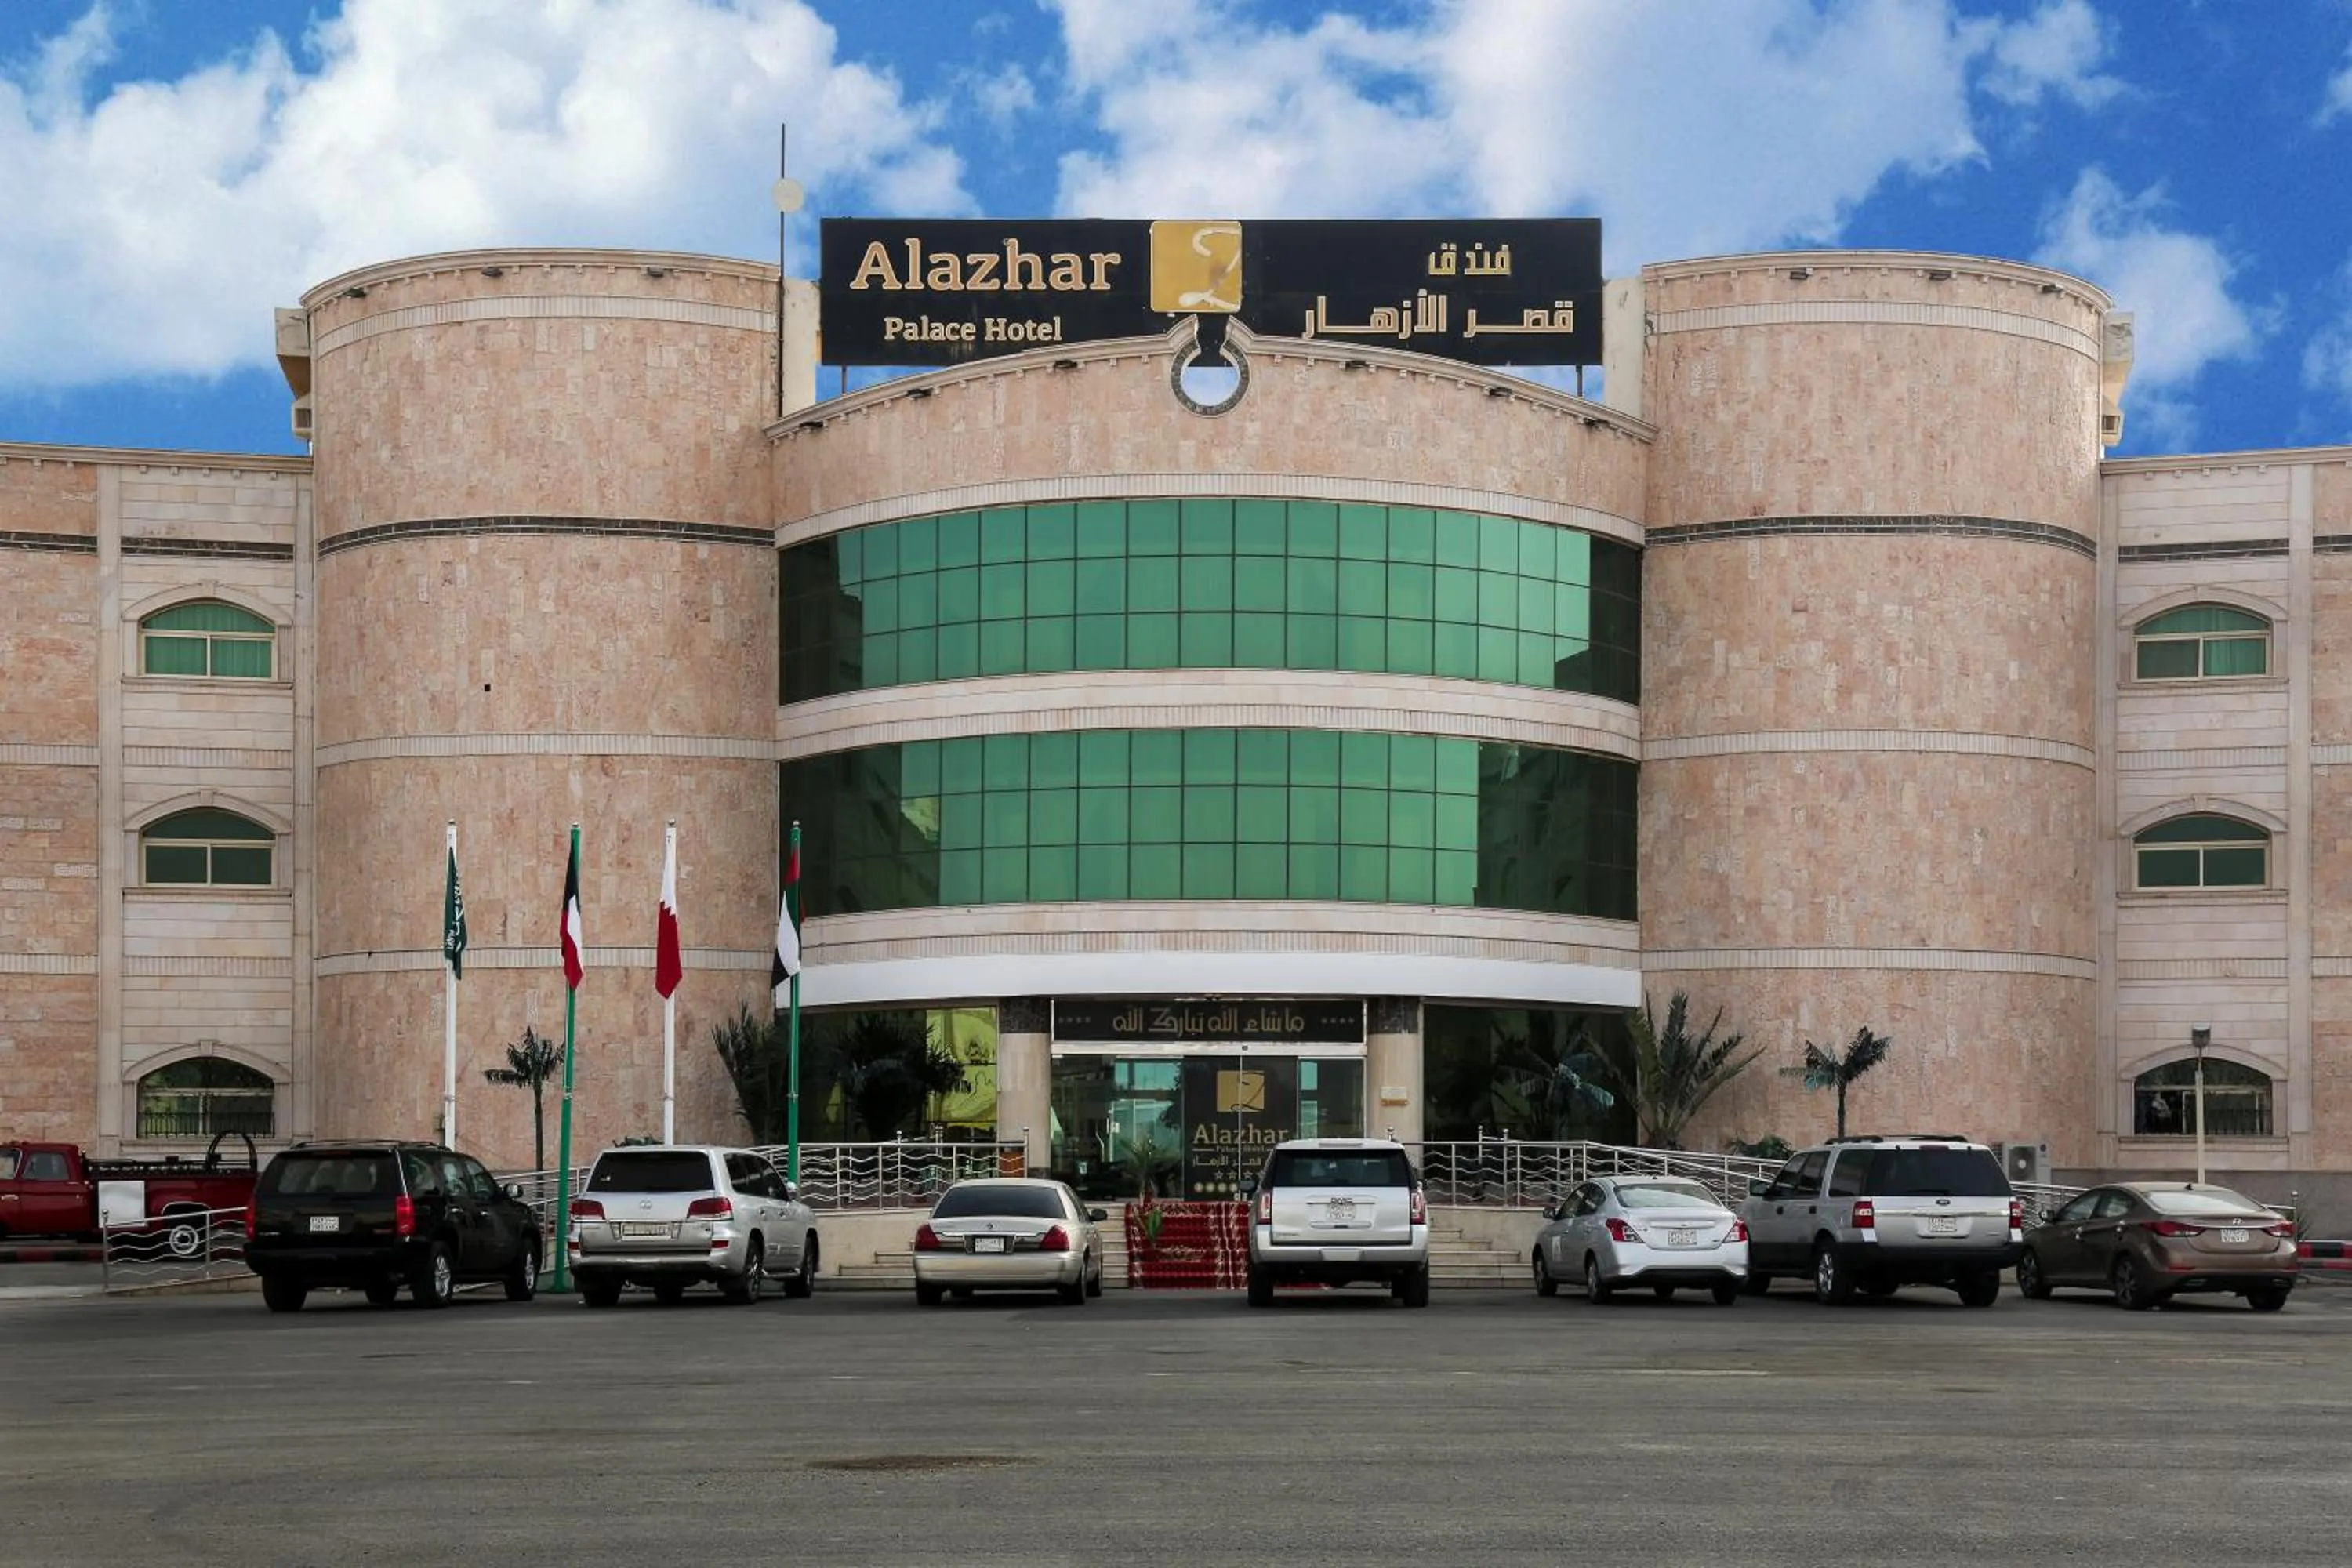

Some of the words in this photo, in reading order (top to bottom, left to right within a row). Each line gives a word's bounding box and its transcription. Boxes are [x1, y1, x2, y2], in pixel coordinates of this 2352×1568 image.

[849, 238, 1122, 291] Alazhar
[1428, 242, 1511, 275] فندق
[1301, 288, 1448, 340] الأزهار
[1463, 300, 1573, 339] قصر
[884, 315, 977, 341] Palace
[984, 316, 1062, 342] Hotel
[1112, 1005, 1144, 1033] الله
[1207, 1006, 1239, 1033] الله
[1285, 1008, 1305, 1033] ما
[1192, 1123, 1290, 1144] Alazhar
